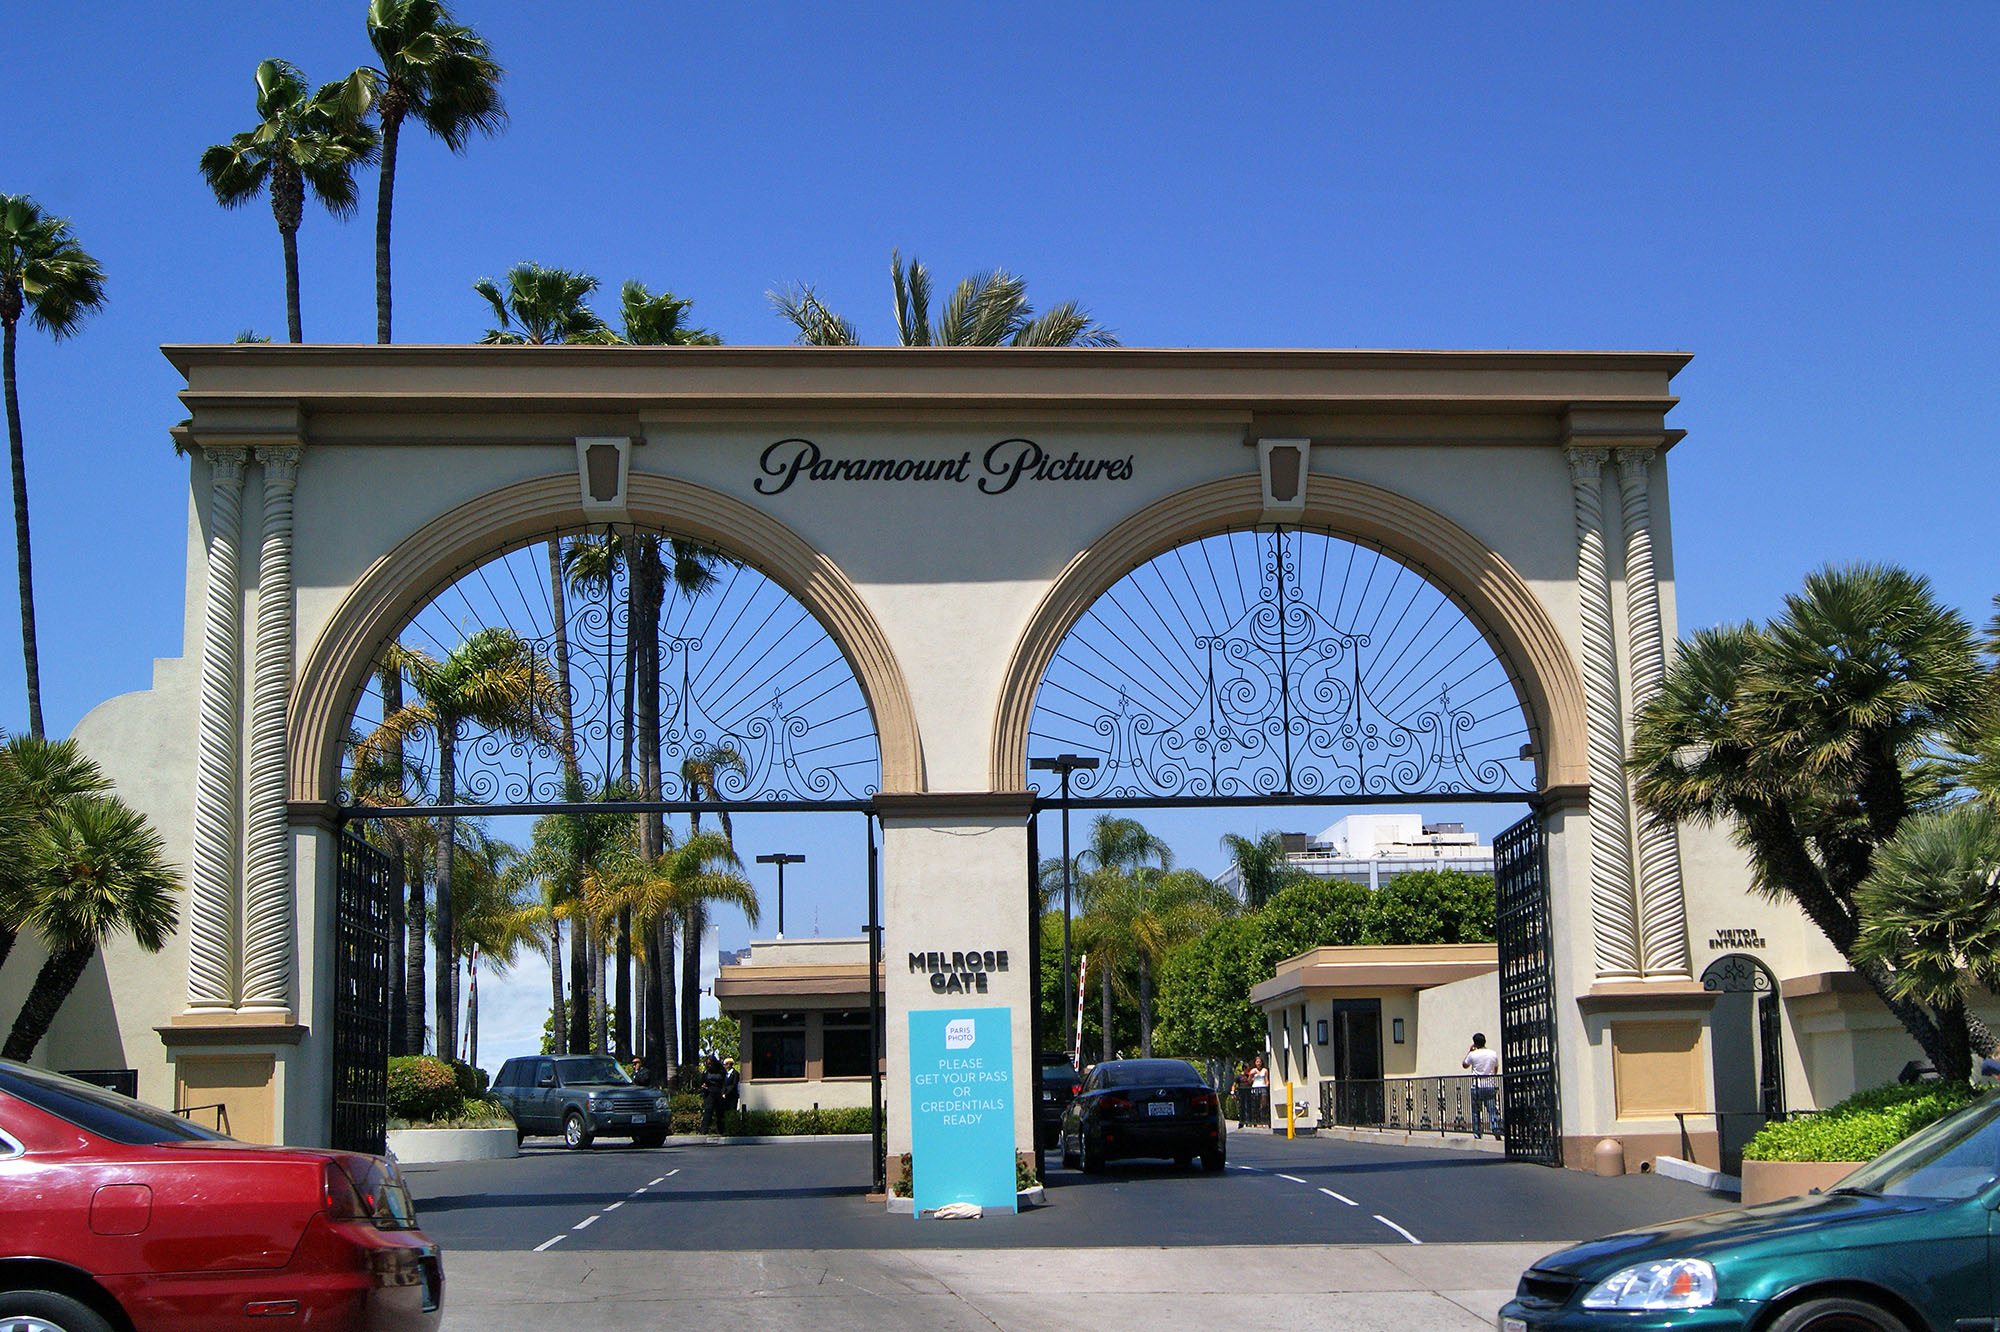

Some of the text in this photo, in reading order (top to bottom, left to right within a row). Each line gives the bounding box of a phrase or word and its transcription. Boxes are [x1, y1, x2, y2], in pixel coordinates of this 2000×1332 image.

[753, 438, 1134, 495] Paramount Pictures
[1716, 929, 1758, 938] VISITOR
[1709, 938, 1766, 949] ENTRANCE
[908, 950, 1009, 974] MELROSE
[930, 972, 988, 994] GATE
[938, 1058, 983, 1070] PLEASE
[915, 1071, 1008, 1085] GET YOUR PASS
[952, 1086, 971, 1097] OR
[920, 1098, 1004, 1113] CREDENTIALS
[943, 1113, 983, 1126] READY
